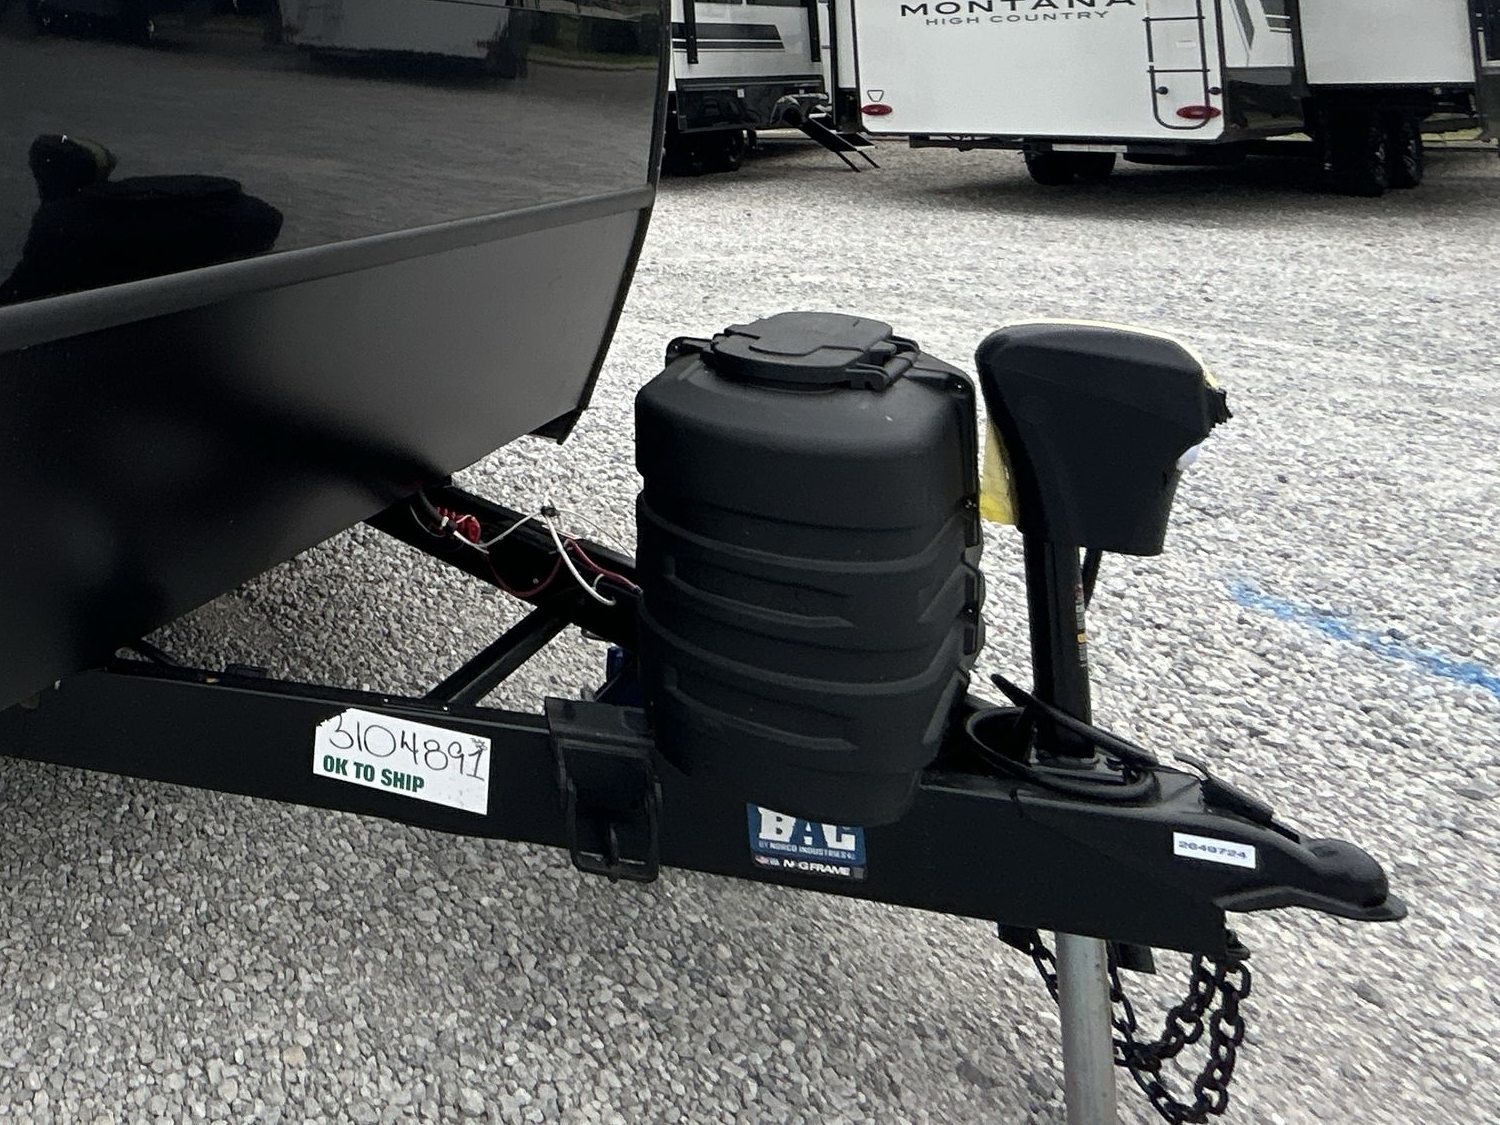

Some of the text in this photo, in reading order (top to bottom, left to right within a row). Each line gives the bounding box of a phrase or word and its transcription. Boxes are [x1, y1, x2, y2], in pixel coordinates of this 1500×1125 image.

[925, 10, 1109, 26] HIGH COUNTRY
[329, 714, 485, 781] 3104891
[323, 755, 425, 793] OK TO SHIP
